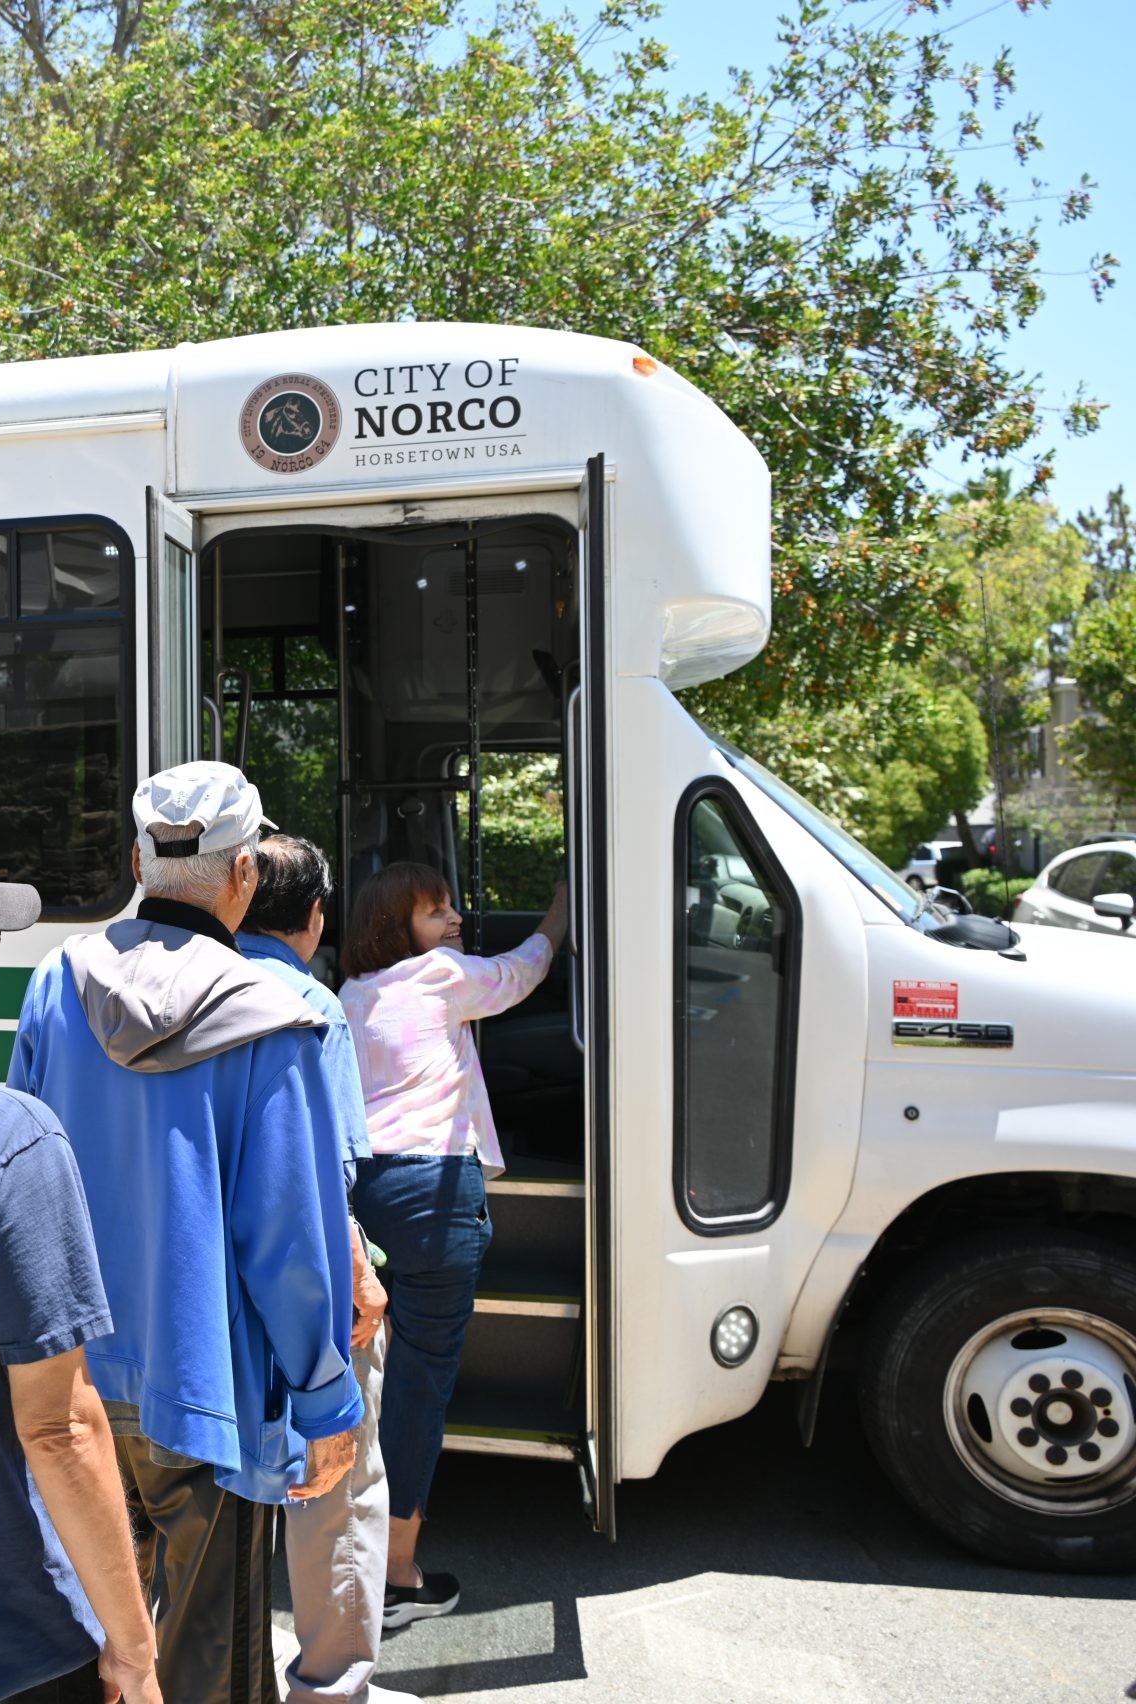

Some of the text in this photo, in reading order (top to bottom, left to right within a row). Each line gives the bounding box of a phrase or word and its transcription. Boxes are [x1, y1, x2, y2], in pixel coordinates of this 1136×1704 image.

[354, 358, 519, 397] CITY OF
[354, 395, 521, 440] NORCO
[250, 445, 266, 460] 19
[270, 456, 314, 472] NORCO
[355, 443, 522, 467] HORSETOWN USA
